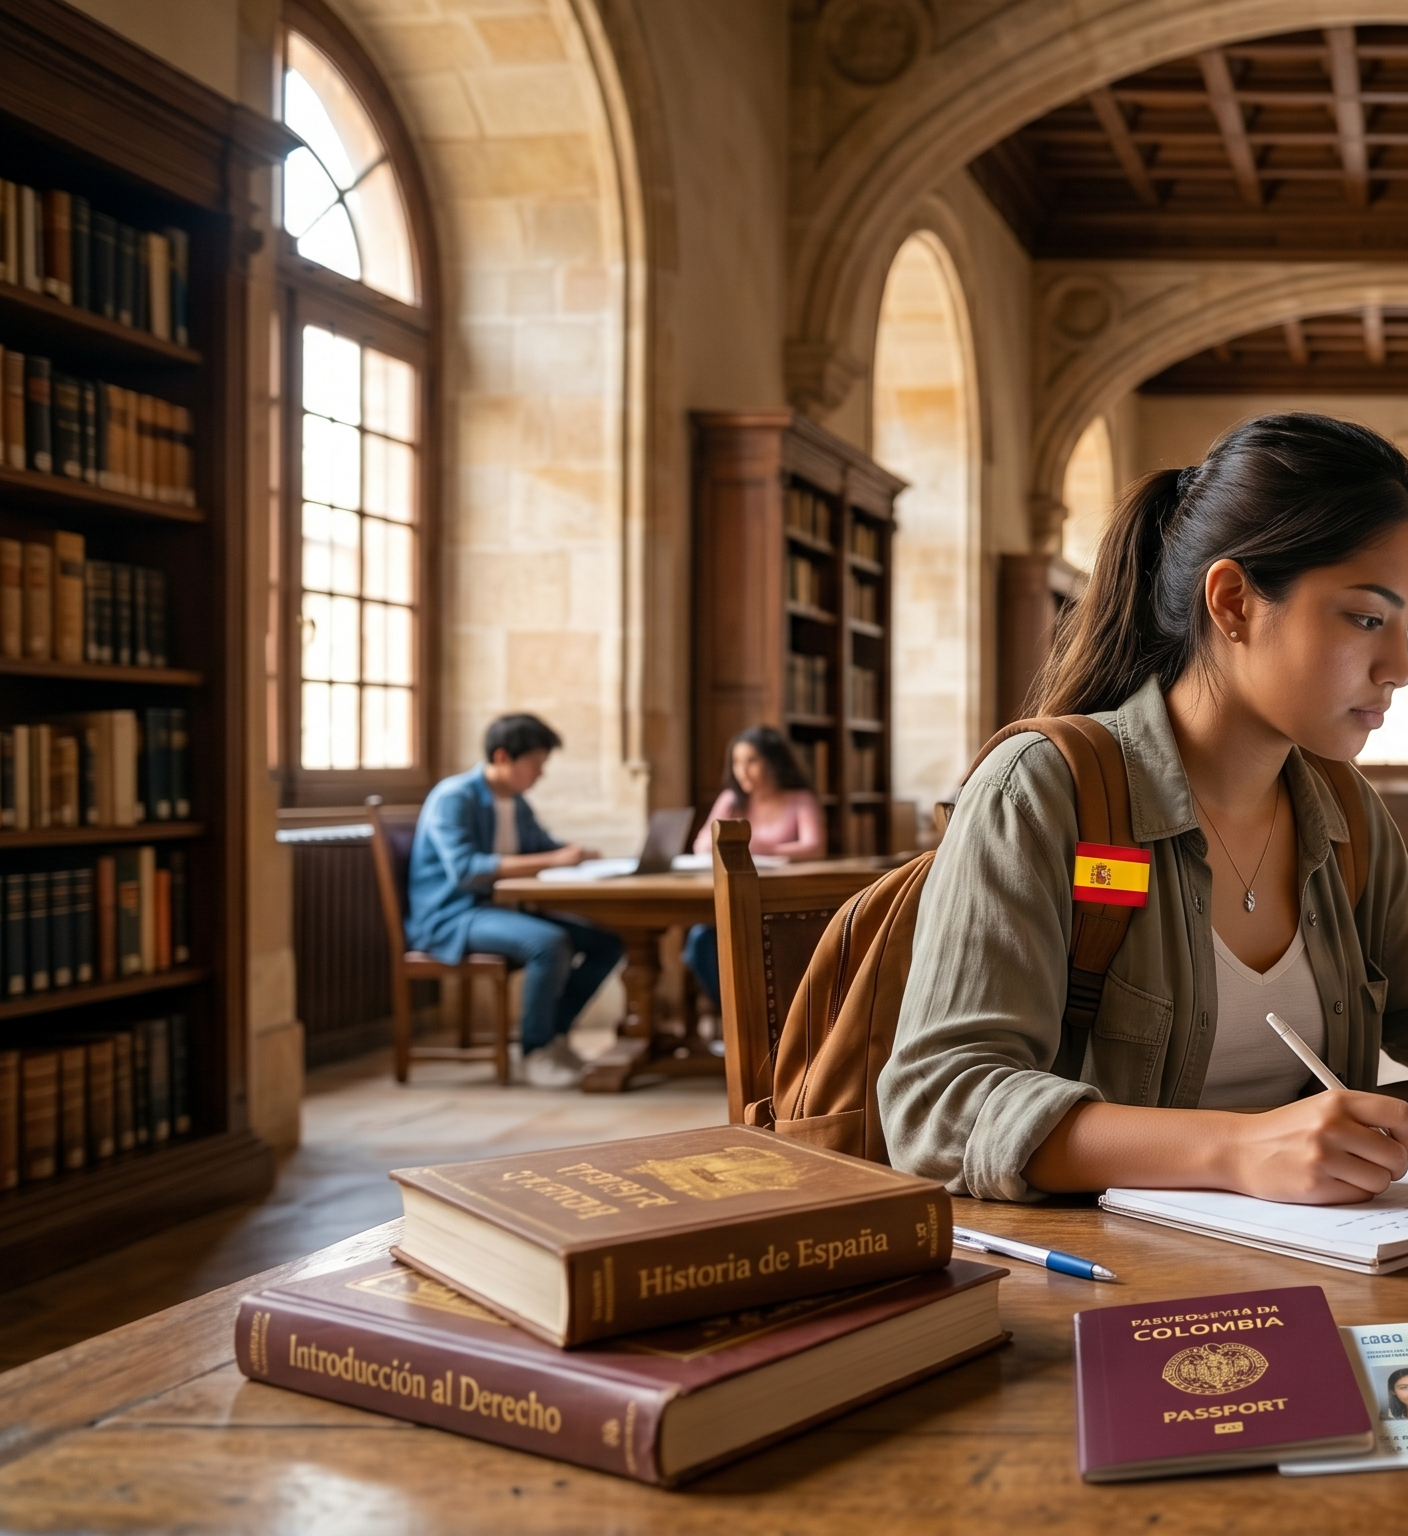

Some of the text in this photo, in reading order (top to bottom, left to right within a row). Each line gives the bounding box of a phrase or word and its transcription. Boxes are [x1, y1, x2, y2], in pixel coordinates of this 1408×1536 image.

[638, 1253, 752, 1299] Historia
[758, 1245, 791, 1275] de
[797, 1228, 889, 1271] España
[1133, 1316, 1285, 1342] COLOMBIA
[289, 1333, 427, 1400] Introducción
[431, 1370, 454, 1407] al
[459, 1376, 562, 1434] Derecho
[1163, 1398, 1289, 1424] PASSPORT
